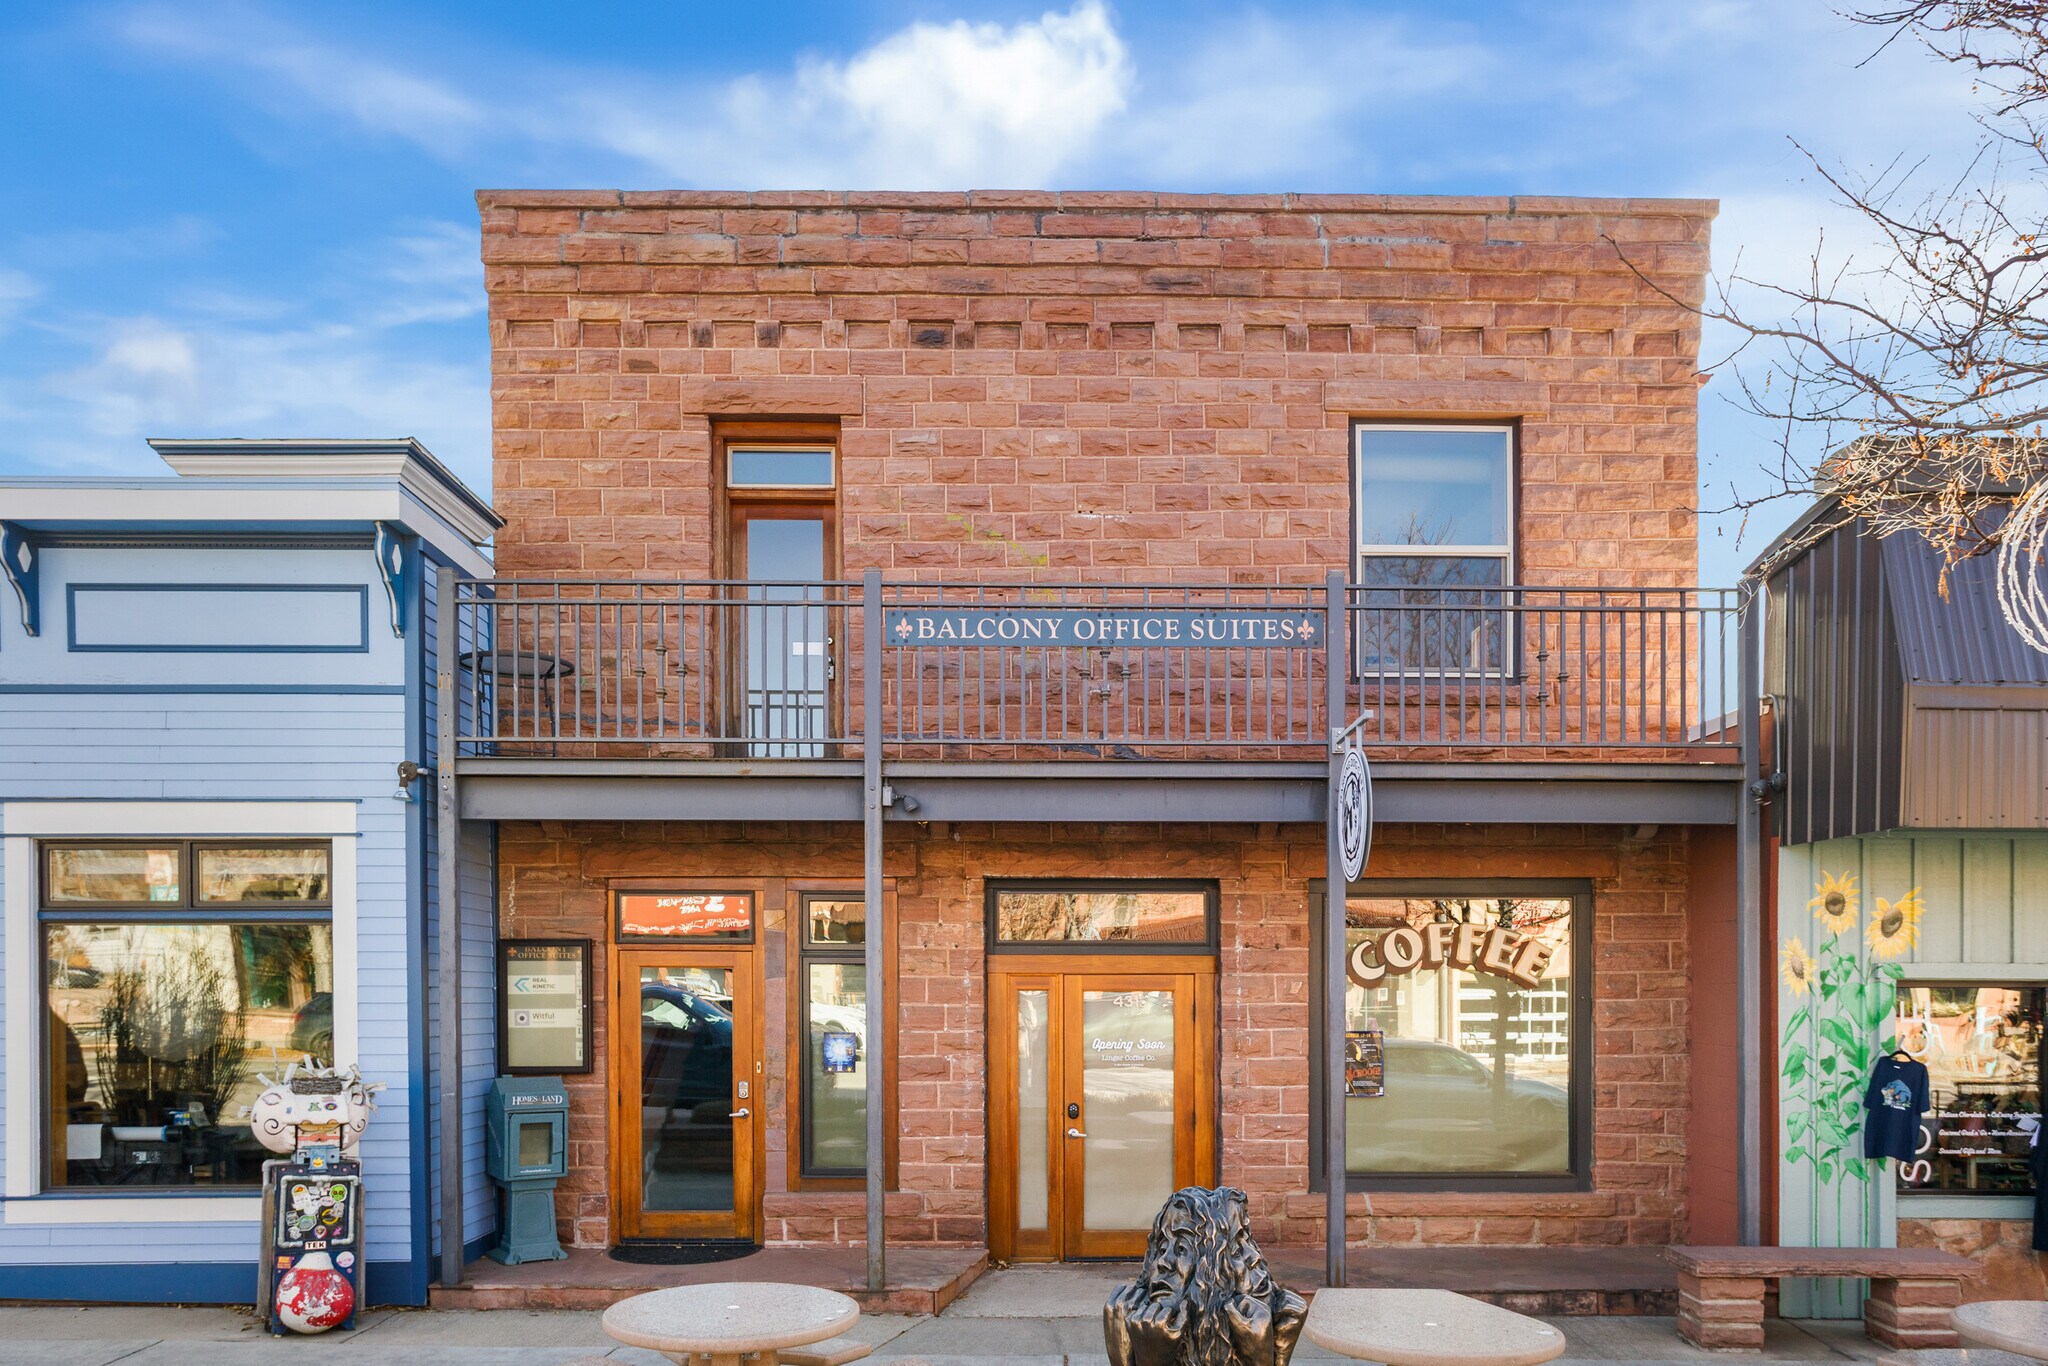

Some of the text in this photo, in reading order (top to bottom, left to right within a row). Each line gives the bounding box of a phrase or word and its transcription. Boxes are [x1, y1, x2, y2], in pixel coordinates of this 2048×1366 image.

[916, 618, 1295, 640] BALCONY OFFICE SUITES
[1349, 922, 1553, 989] COFFEE
[532, 1012, 555, 1020] Witful
[1092, 1038, 1166, 1053] Opening Soon
